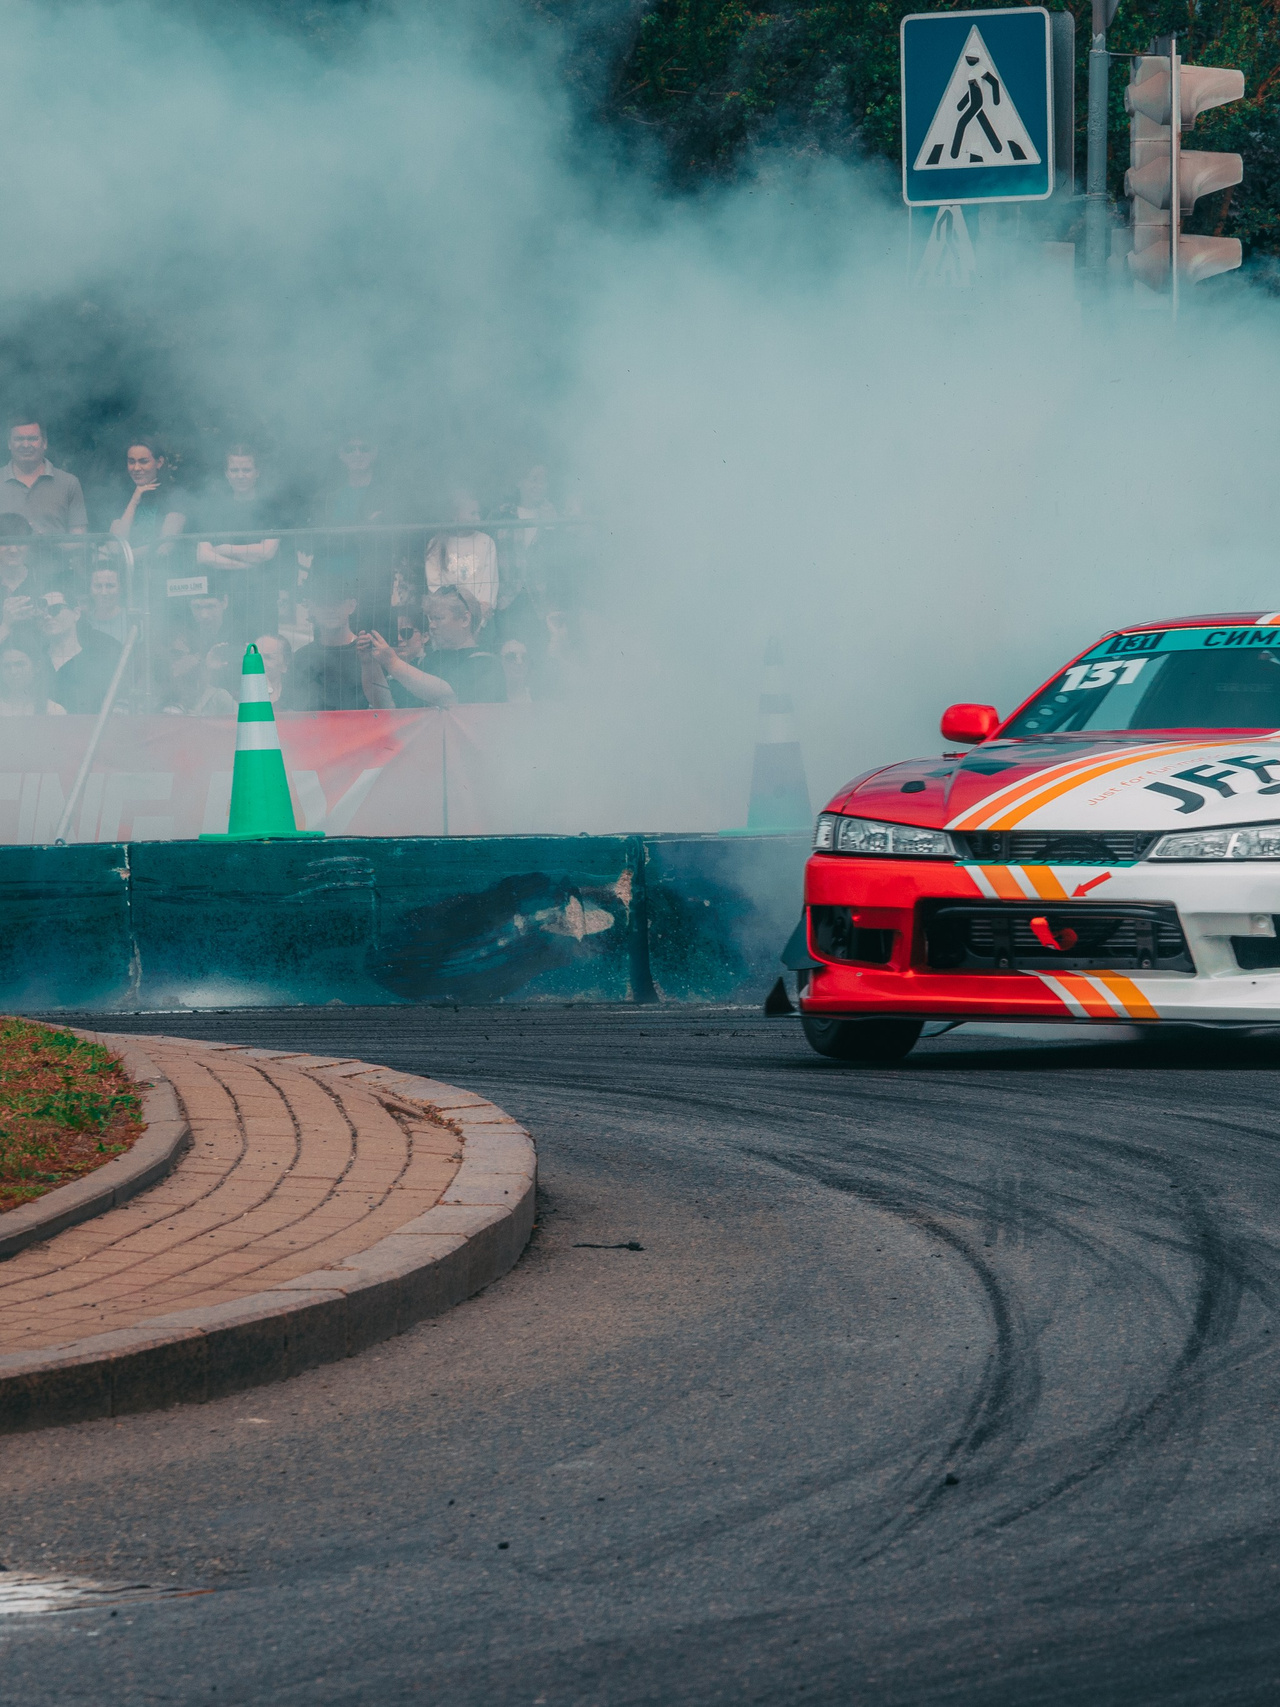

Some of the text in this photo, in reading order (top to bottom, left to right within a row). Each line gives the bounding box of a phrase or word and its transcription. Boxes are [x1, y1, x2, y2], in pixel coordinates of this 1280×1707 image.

[1112, 634, 1157, 651] 131
[1060, 658, 1149, 692] 131
[1120, 775, 1145, 787] for
